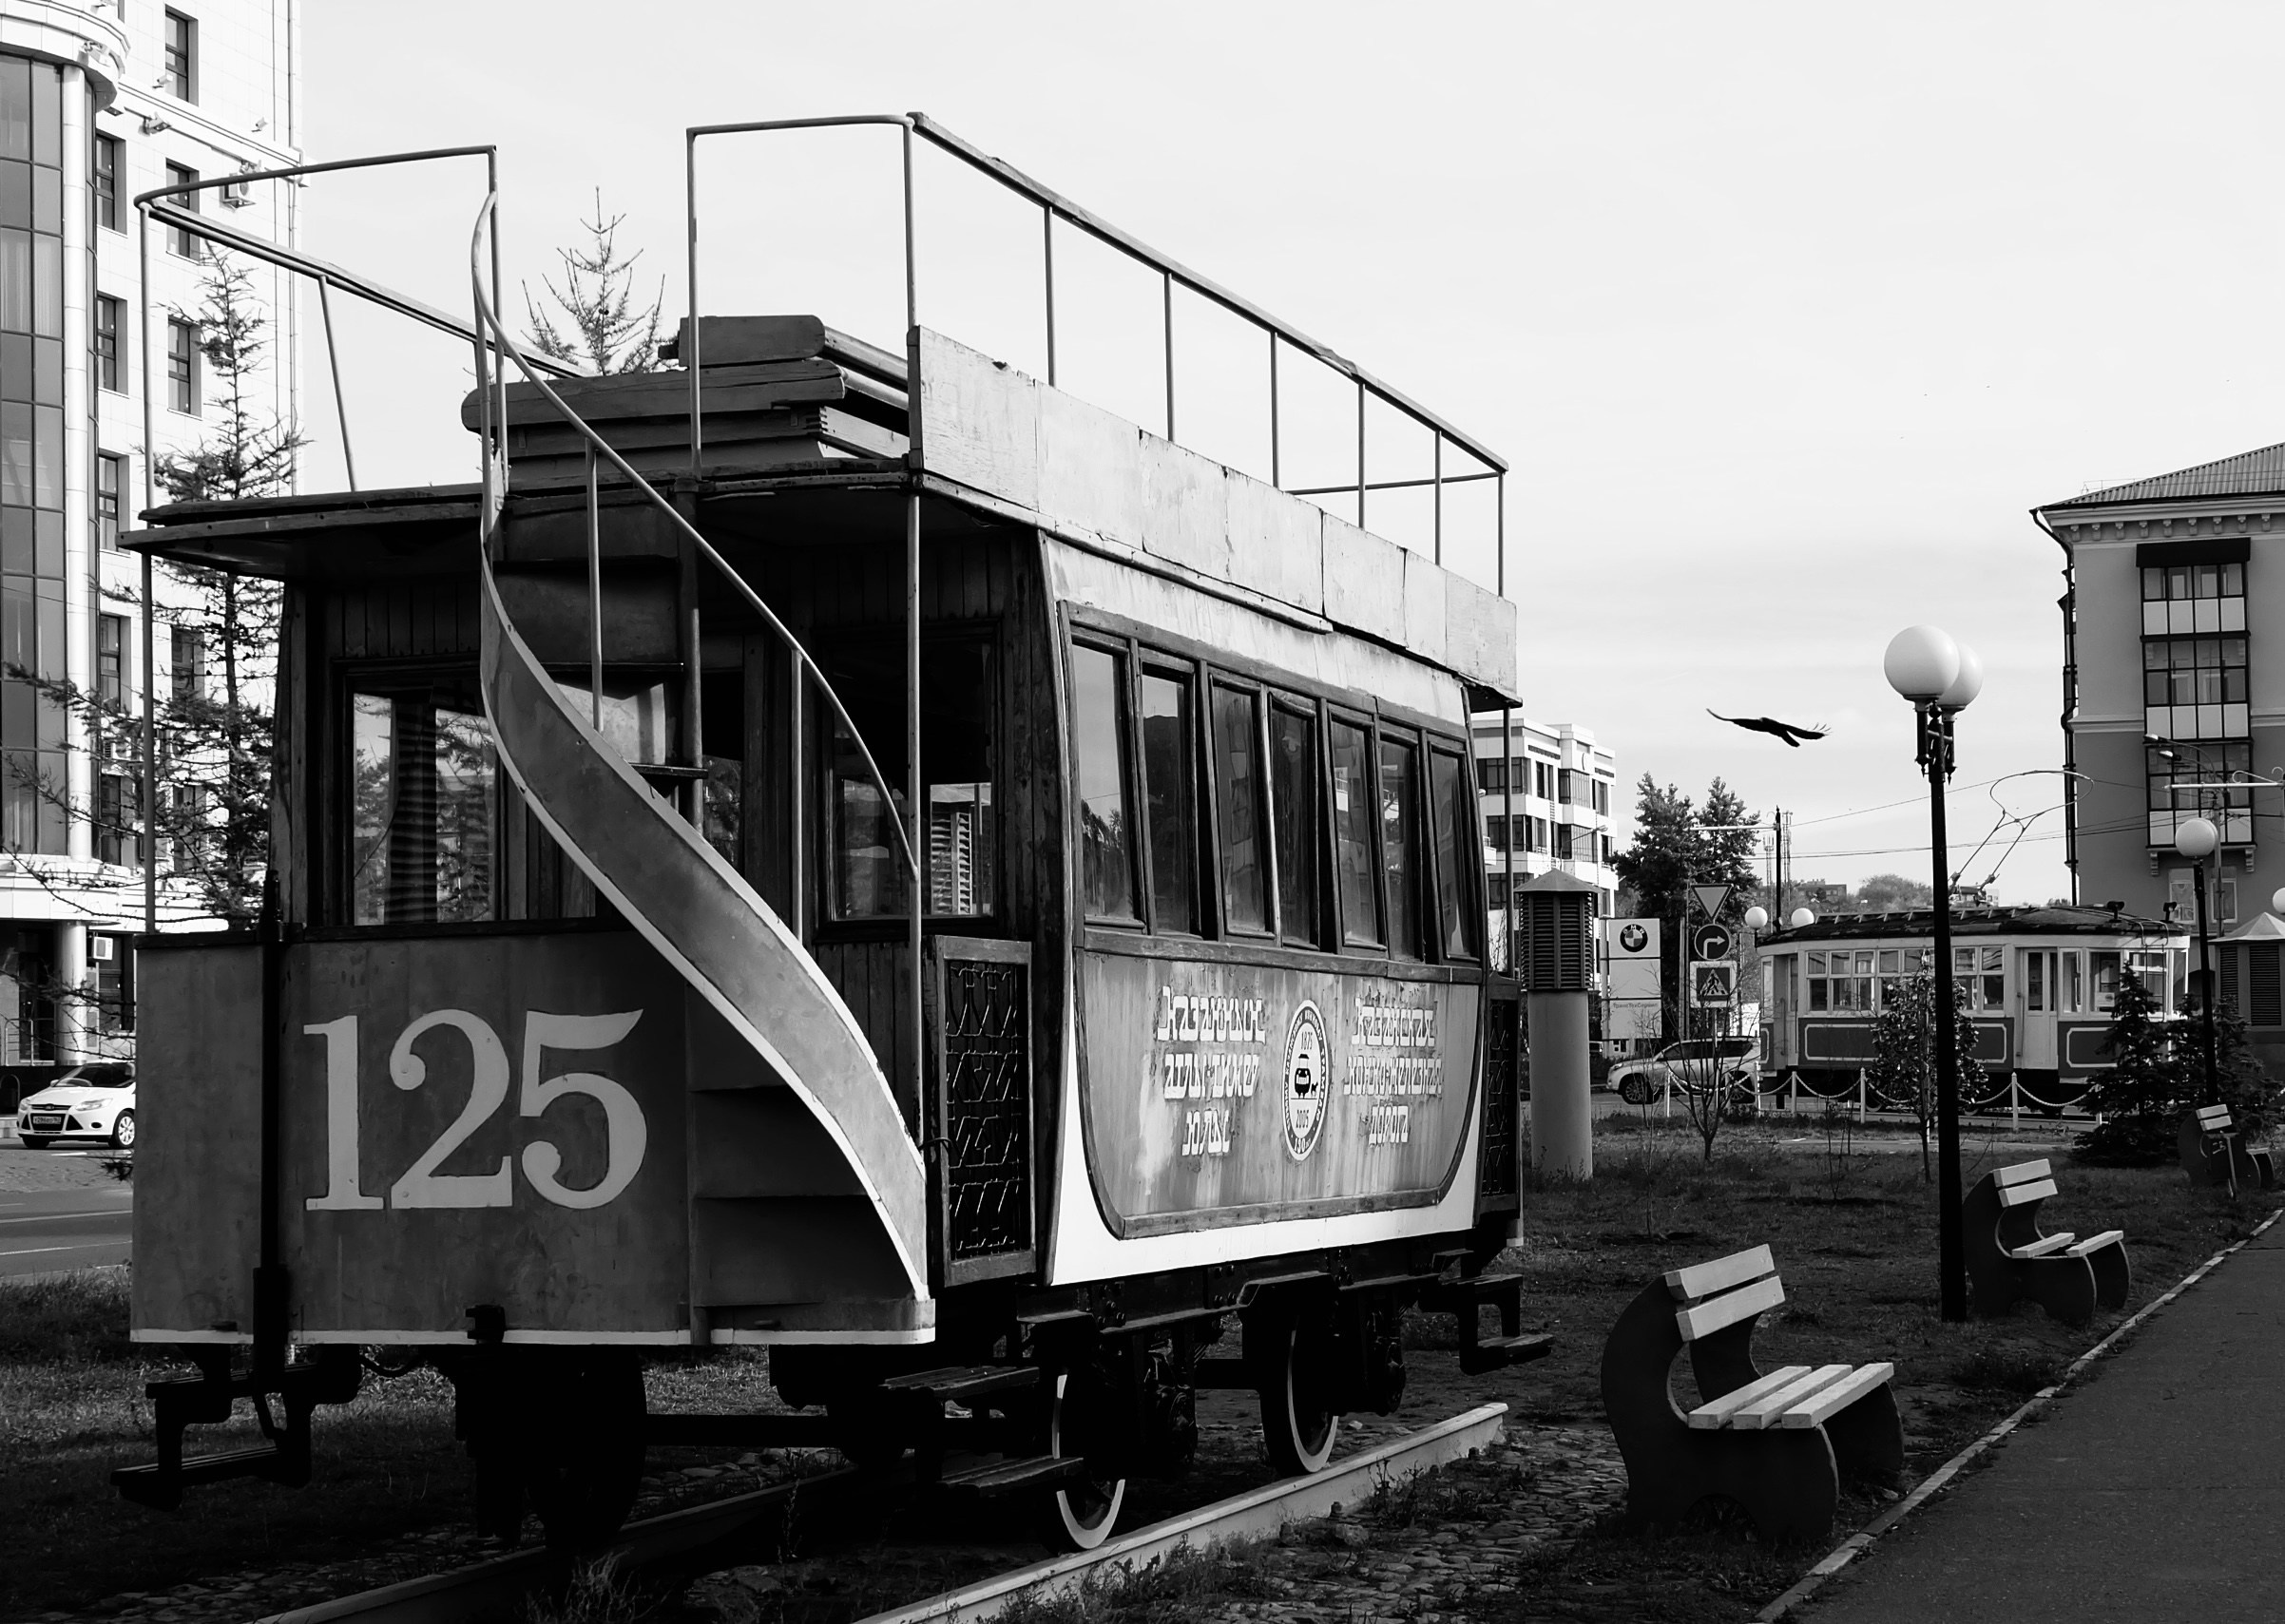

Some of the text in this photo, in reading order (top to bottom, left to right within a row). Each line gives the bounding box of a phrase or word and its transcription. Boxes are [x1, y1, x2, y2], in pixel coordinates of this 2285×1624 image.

[1623, 925, 1645, 934] BMW
[1300, 1031, 1313, 1050] 1875
[303, 1008, 647, 1211] 125
[1294, 1137, 1306, 1154] 130
